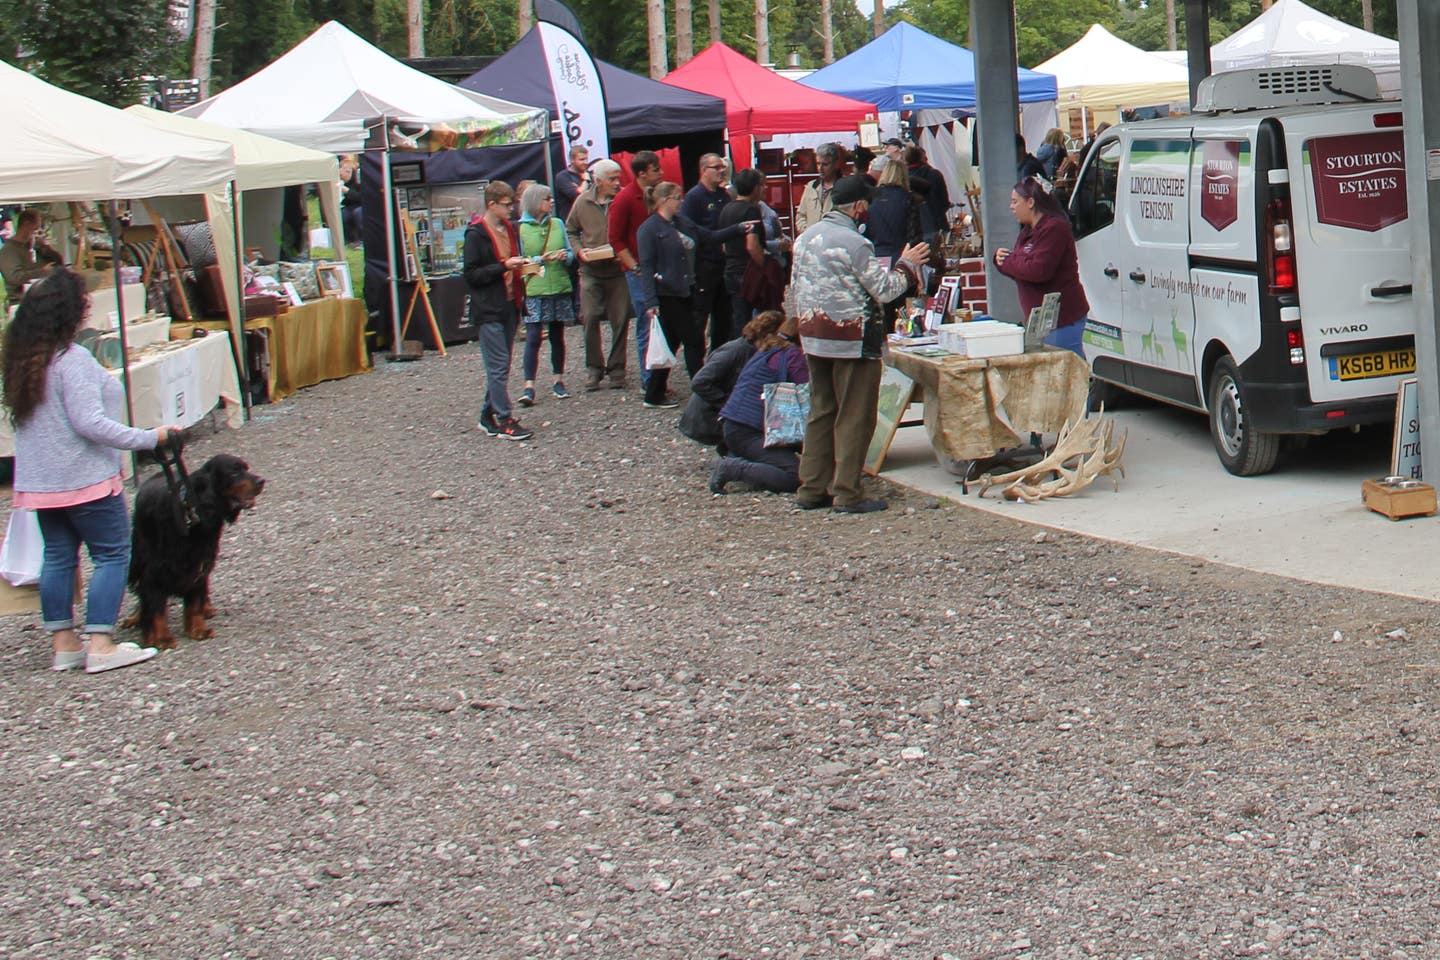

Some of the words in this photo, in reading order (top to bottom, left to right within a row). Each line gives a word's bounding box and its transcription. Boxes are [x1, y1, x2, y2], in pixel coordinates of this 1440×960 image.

[1207, 160, 1233, 171] STOURTON
[1326, 150, 1402, 170] STOURTON
[1130, 177, 1185, 197] LINCOLNSHIRE
[1208, 183, 1230, 194] ESTATES
[1339, 177, 1397, 194] ESTATES
[1140, 201, 1173, 220] VENISON
[1150, 268, 1176, 299] Lovingly
[1177, 274, 1200, 296] reared
[1202, 284, 1211, 298] on
[1212, 285, 1226, 301] our
[1227, 281, 1247, 308] farm
[1320, 324, 1368, 335] VIVARO
[1340, 354, 1384, 376] KS68
